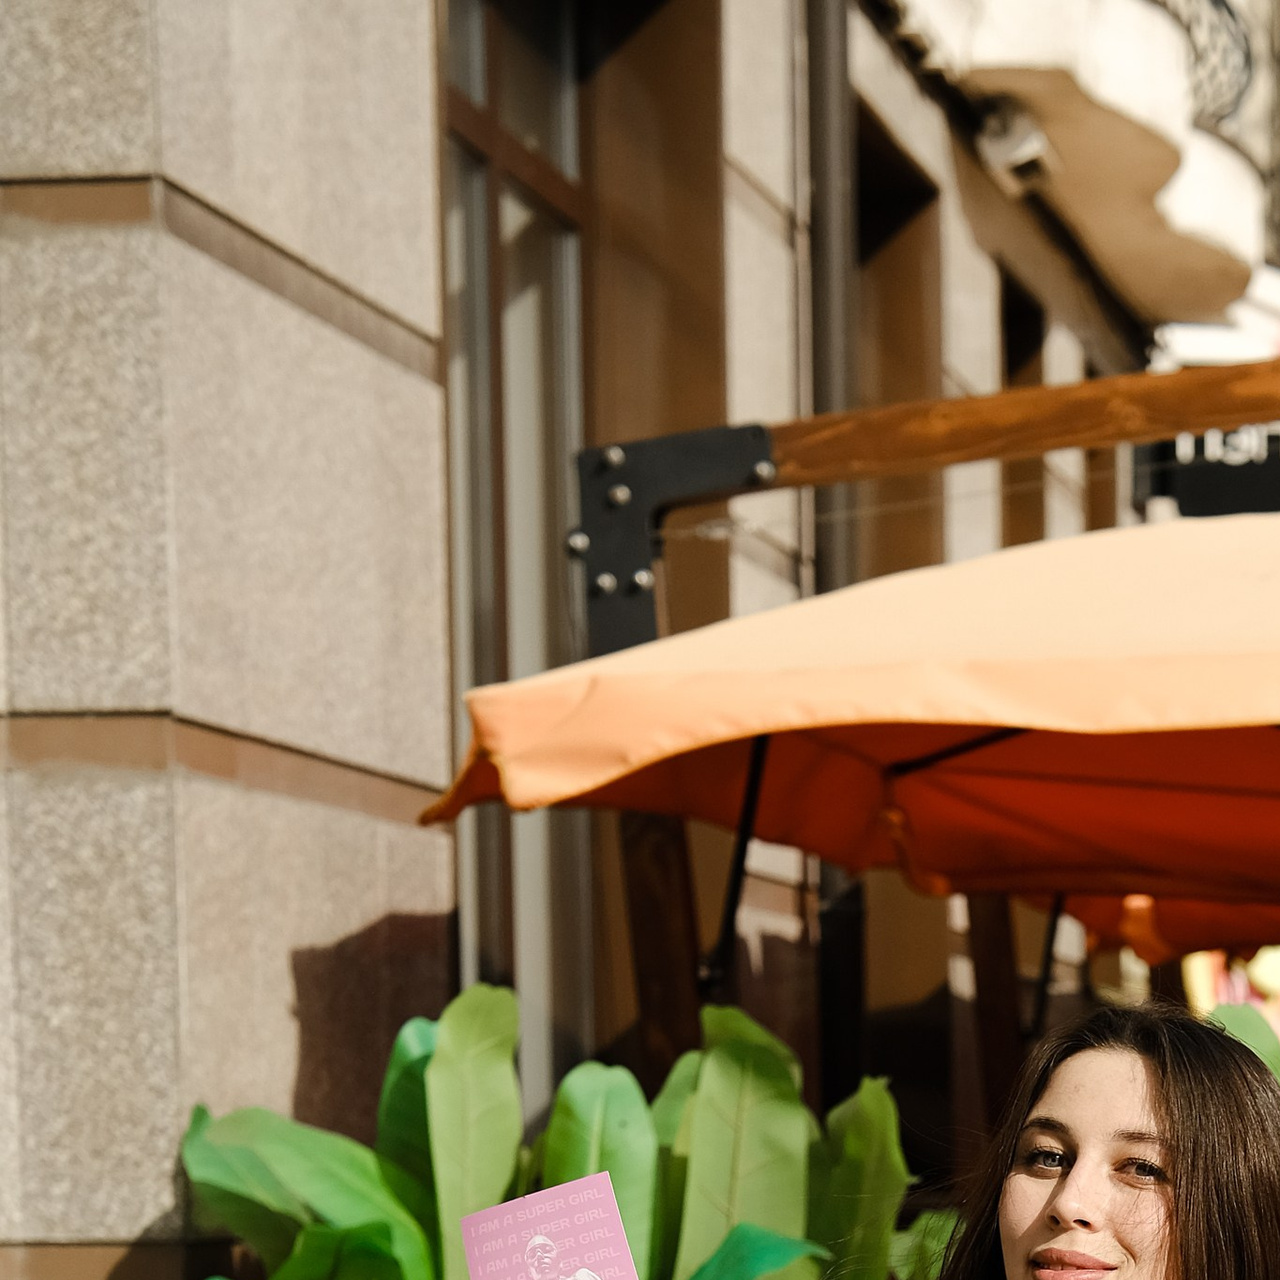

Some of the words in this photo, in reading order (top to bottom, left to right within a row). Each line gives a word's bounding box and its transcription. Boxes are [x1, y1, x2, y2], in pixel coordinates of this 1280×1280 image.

[478, 1220, 500, 1234] AM
[503, 1215, 513, 1226] A
[517, 1198, 565, 1222] SUPER
[568, 1188, 604, 1205] GIRL
[482, 1238, 504, 1254] AM
[508, 1234, 518, 1246] A
[521, 1218, 571, 1241] SUPER
[574, 1207, 609, 1224] GIRL
[487, 1258, 508, 1273] AM
[512, 1254, 522, 1265] A
[579, 1227, 615, 1244] GIRL
[584, 1246, 620, 1263] GIRL
